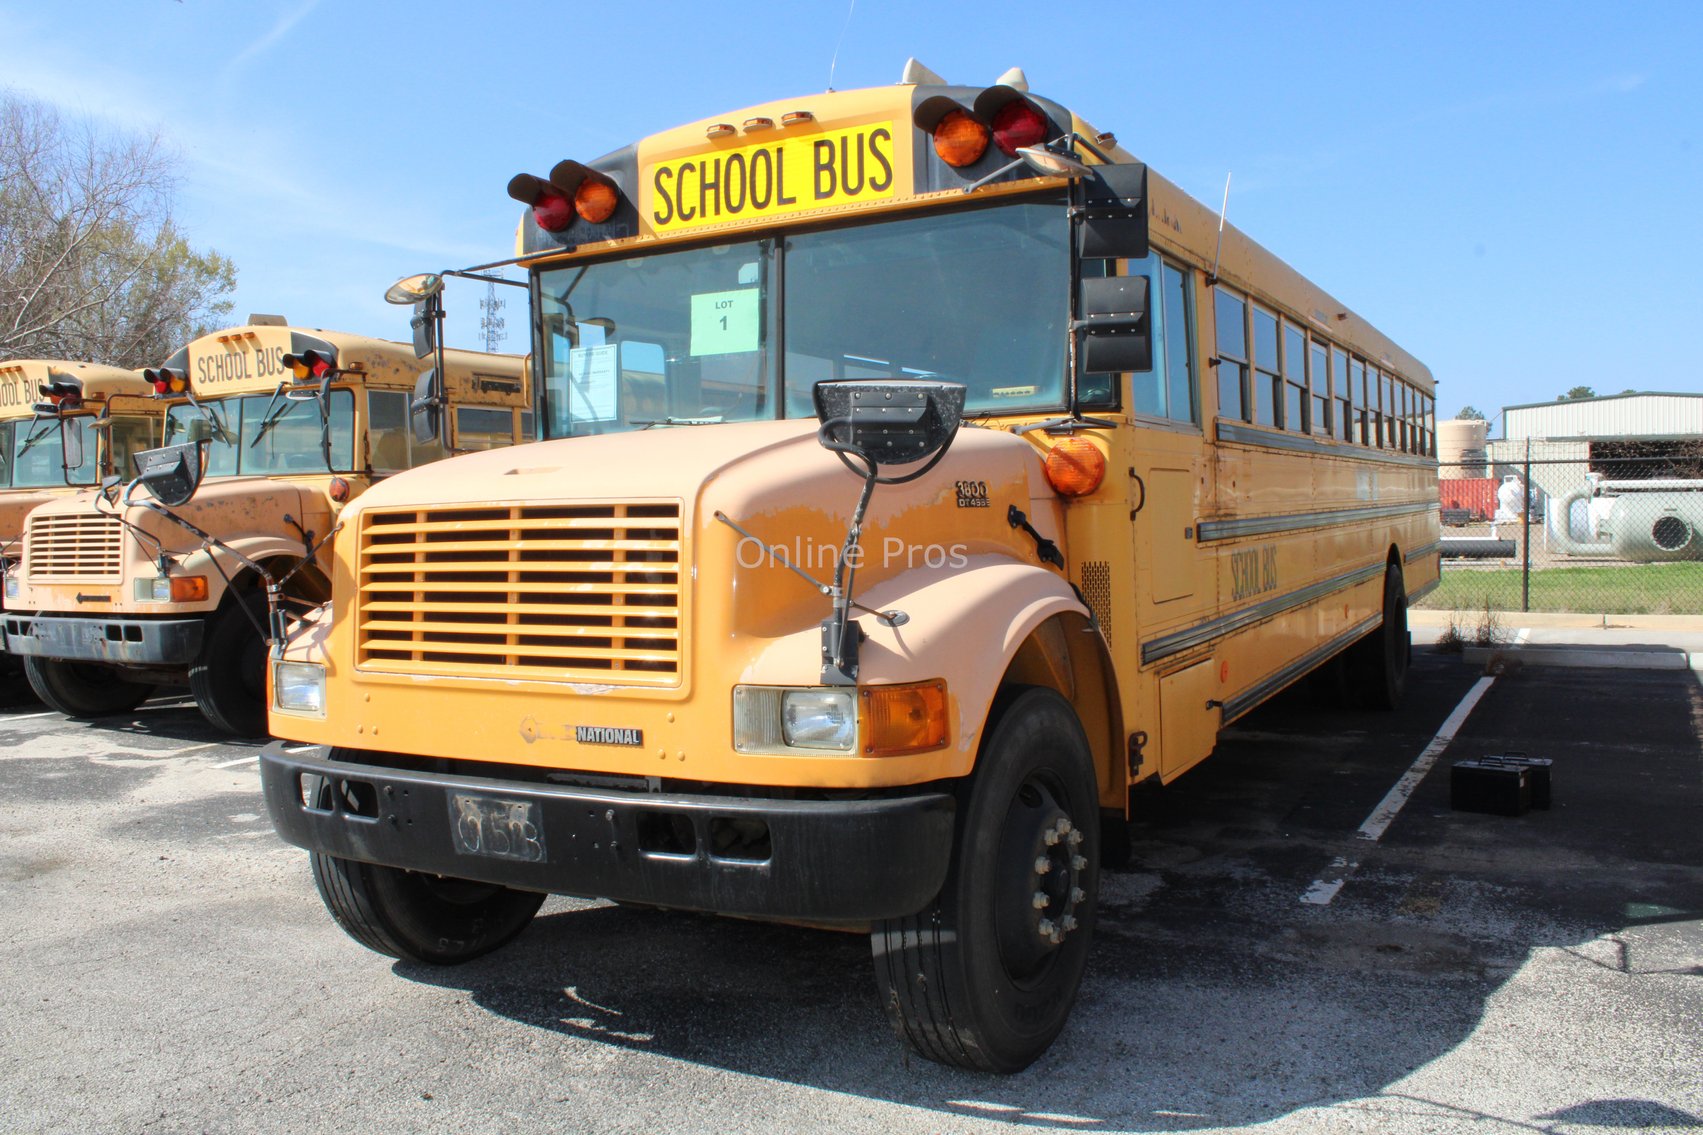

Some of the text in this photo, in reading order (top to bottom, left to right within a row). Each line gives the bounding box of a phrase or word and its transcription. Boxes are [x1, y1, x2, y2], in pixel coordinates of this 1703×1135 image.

[654, 128, 893, 225] SCHOOL BUS
[715, 300, 733, 309] LOT
[719, 315, 727, 331] 1
[198, 346, 285, 384] SCHOOL BUS
[577, 726, 640, 745] NATIONAL
